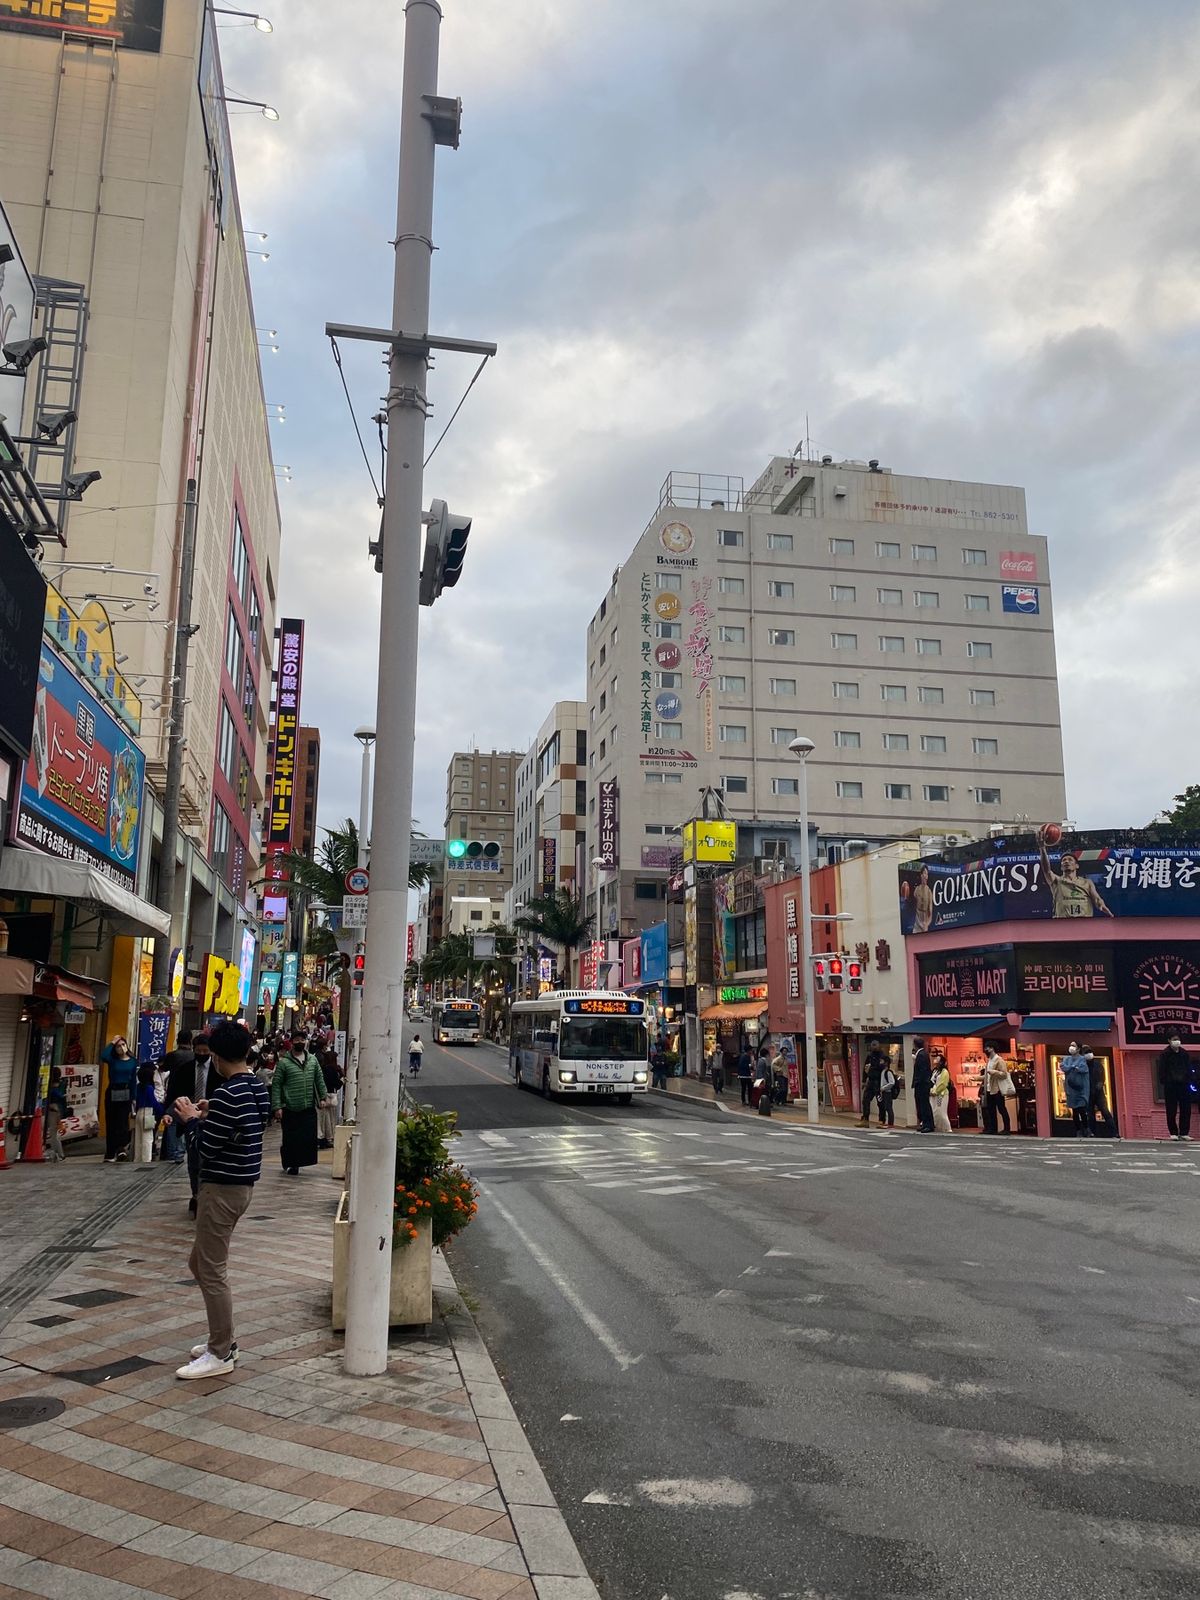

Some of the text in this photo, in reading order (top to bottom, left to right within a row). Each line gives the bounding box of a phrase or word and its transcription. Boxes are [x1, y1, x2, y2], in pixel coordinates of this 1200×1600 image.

[1003, 586, 1036, 596] PEPSI
[281, 632, 300, 707] 驚安の殿堂
[50, 721, 109, 803] ドーナツ棒
[272, 714, 297, 832] ドン・キホーテ
[18, 812, 74, 860] 商品に関するお問合せ
[603, 798, 613, 864] ホテル山の内
[448, 860, 499, 871] 時差式信号機
[1104, 857, 1200, 889] 沖縄を
[1070, 905, 1081, 915] 14
[925, 968, 1007, 997] KOREA MART
[1023, 974, 1108, 993] 코리아마트
[1024, 964, 1104, 973] 沖縄で出会う韓国
[1148, 1009, 1193, 1020] 코리아마트
[149, 1017, 166, 1063] 海ぶど
